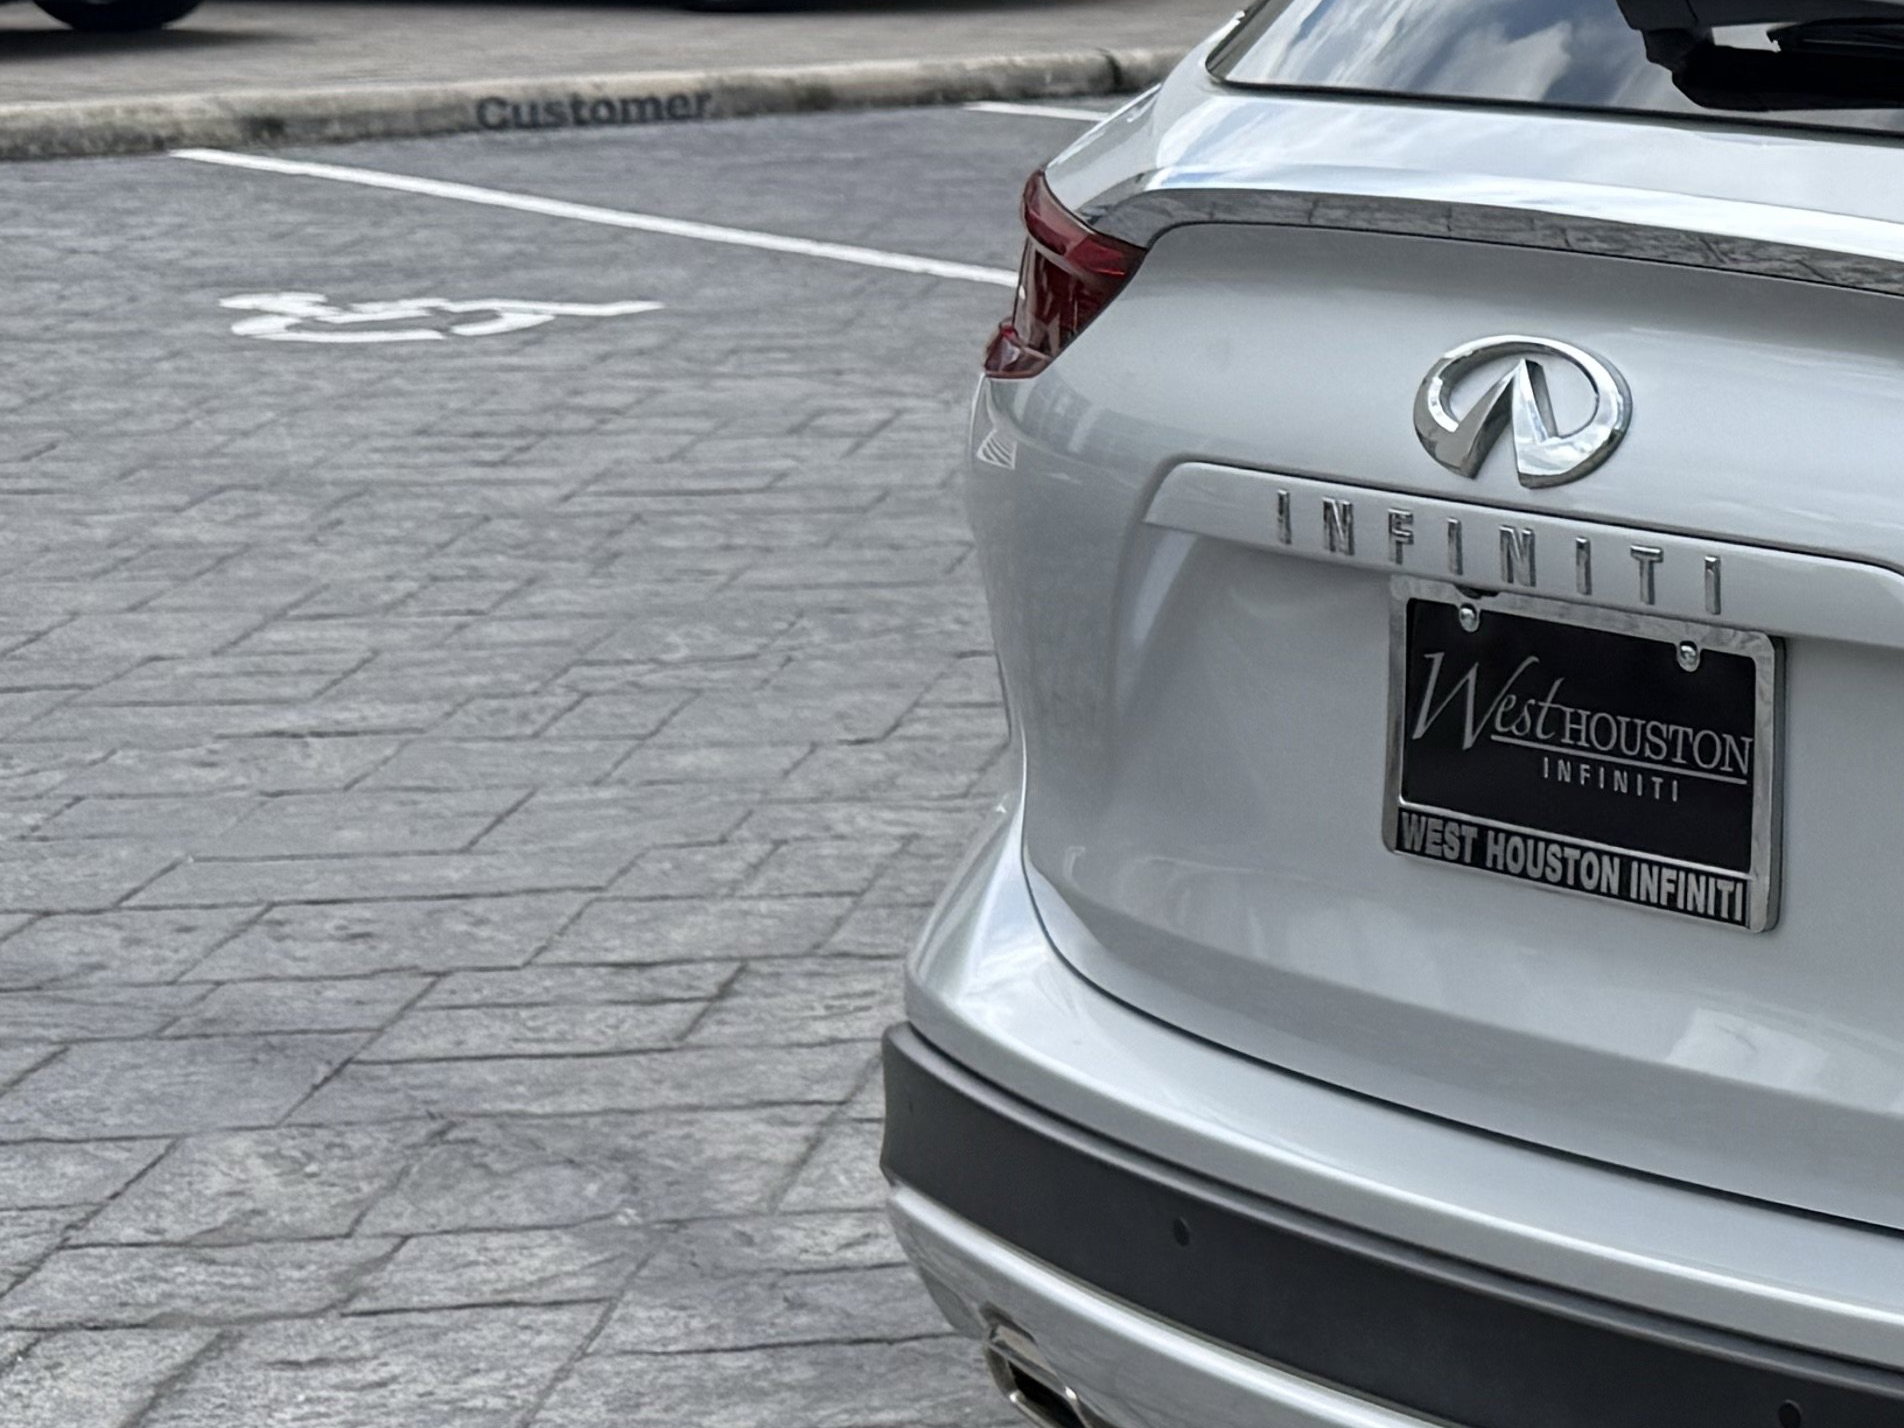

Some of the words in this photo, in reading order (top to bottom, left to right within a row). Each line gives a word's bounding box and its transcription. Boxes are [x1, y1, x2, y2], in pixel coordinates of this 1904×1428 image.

[475, 91, 712, 130] Customer
[1276, 488, 1722, 616] INFINITI
[1411, 651, 1566, 751] West
[1560, 706, 1754, 776] HOUSTON
[1542, 756, 1680, 803] INFINITI
[1401, 810, 1479, 864] WEST
[1486, 829, 1621, 897] HOUSTON
[1629, 860, 1745, 923] INFINITI
